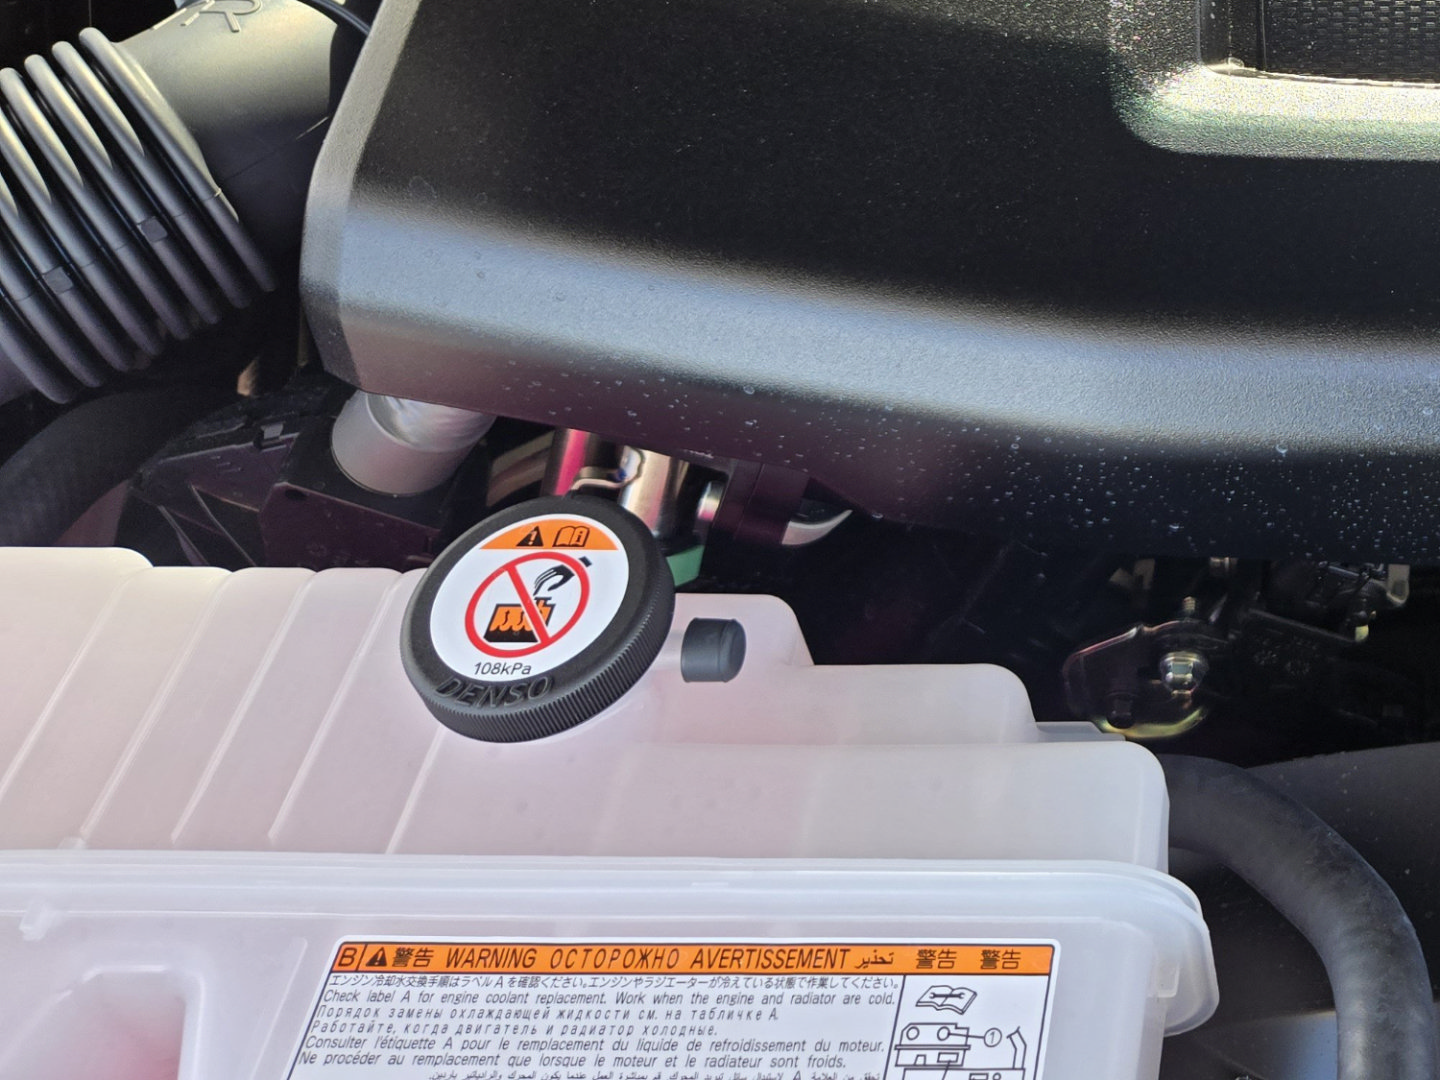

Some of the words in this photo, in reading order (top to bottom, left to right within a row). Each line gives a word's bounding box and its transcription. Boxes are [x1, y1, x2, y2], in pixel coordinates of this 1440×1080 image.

[473, 662, 532, 676] 108kPa
[433, 677, 555, 708] DENSO
[338, 947, 358, 967] B
[392, 948, 434, 969] 警告
[445, 948, 538, 969] WARNING
[550, 948, 680, 969] ОСТОРОЖНО
[690, 948, 851, 969] AVERTISSEMENT
[854, 949, 894, 969] تحذير
[916, 949, 957, 970] 警告
[980, 949, 1022, 970] 警告
[323, 989, 361, 1003] Check
[366, 990, 397, 1004] label
[400, 990, 411, 1003] A
[417, 989, 435, 1003] for
[440, 990, 480, 1005] engine
[485, 990, 530, 1005] coolant
[535, 991, 606, 1007] replacement.
[615, 991, 647, 1004] Work
[652, 991, 684, 1004] when
[690, 991, 710, 1004] the
[715, 992, 755, 1007] engine
[760, 992, 785, 1006] and
[789, 991, 837, 1005] radiator
[842, 994, 862, 1005] are
[868, 992, 896, 1006] cold.
[316, 1005, 381, 1019] Порядок
[388, 1008, 444, 1019] замены
[449, 1005, 551, 1020] охлаждающей
[555, 1009, 631, 1021] жидкости
[637, 1009, 658, 1020] см.
[664, 1009, 682, 1020] на
[691, 1007, 763, 1022] табличке
[311, 1021, 397, 1036] Работайте,
[403, 1023, 449, 1036] когда
[454, 1023, 538, 1036] двигатель
[545, 1025, 555, 1036] и
[559, 1024, 635, 1037] радиатор
[641, 1024, 718, 1038] холодные.
[305, 1036, 367, 1051] Consulter
[374, 1036, 437, 1052] l'étiquette
[442, 1038, 453, 1050] A
[459, 1039, 492, 1051] pour
[497, 1037, 511, 1051] le
[516, 1038, 605, 1053] remplacement
[611, 1038, 630, 1051] du
[635, 1037, 679, 1053] liquide
[685, 1039, 703, 1052] de
[709, 1039, 807, 1053] refroidissement
[814, 1038, 832, 1052] du
[838, 1039, 885, 1052] moteur.
[298, 1051, 317, 1065] Ne
[322, 1051, 382, 1067] procéder
[387, 1054, 406, 1065] au
[411, 1051, 501, 1067] remplacement
[507, 1056, 532, 1069] que
[538, 1054, 587, 1068] lorsque
[593, 1053, 606, 1067] le
[612, 1055, 659, 1067] moteur
[664, 1056, 679, 1068] et
[684, 1054, 697, 1068] le
[703, 1055, 764, 1069] radiateur
[769, 1055, 800, 1068] sont
[807, 1054, 846, 1068] froids.
